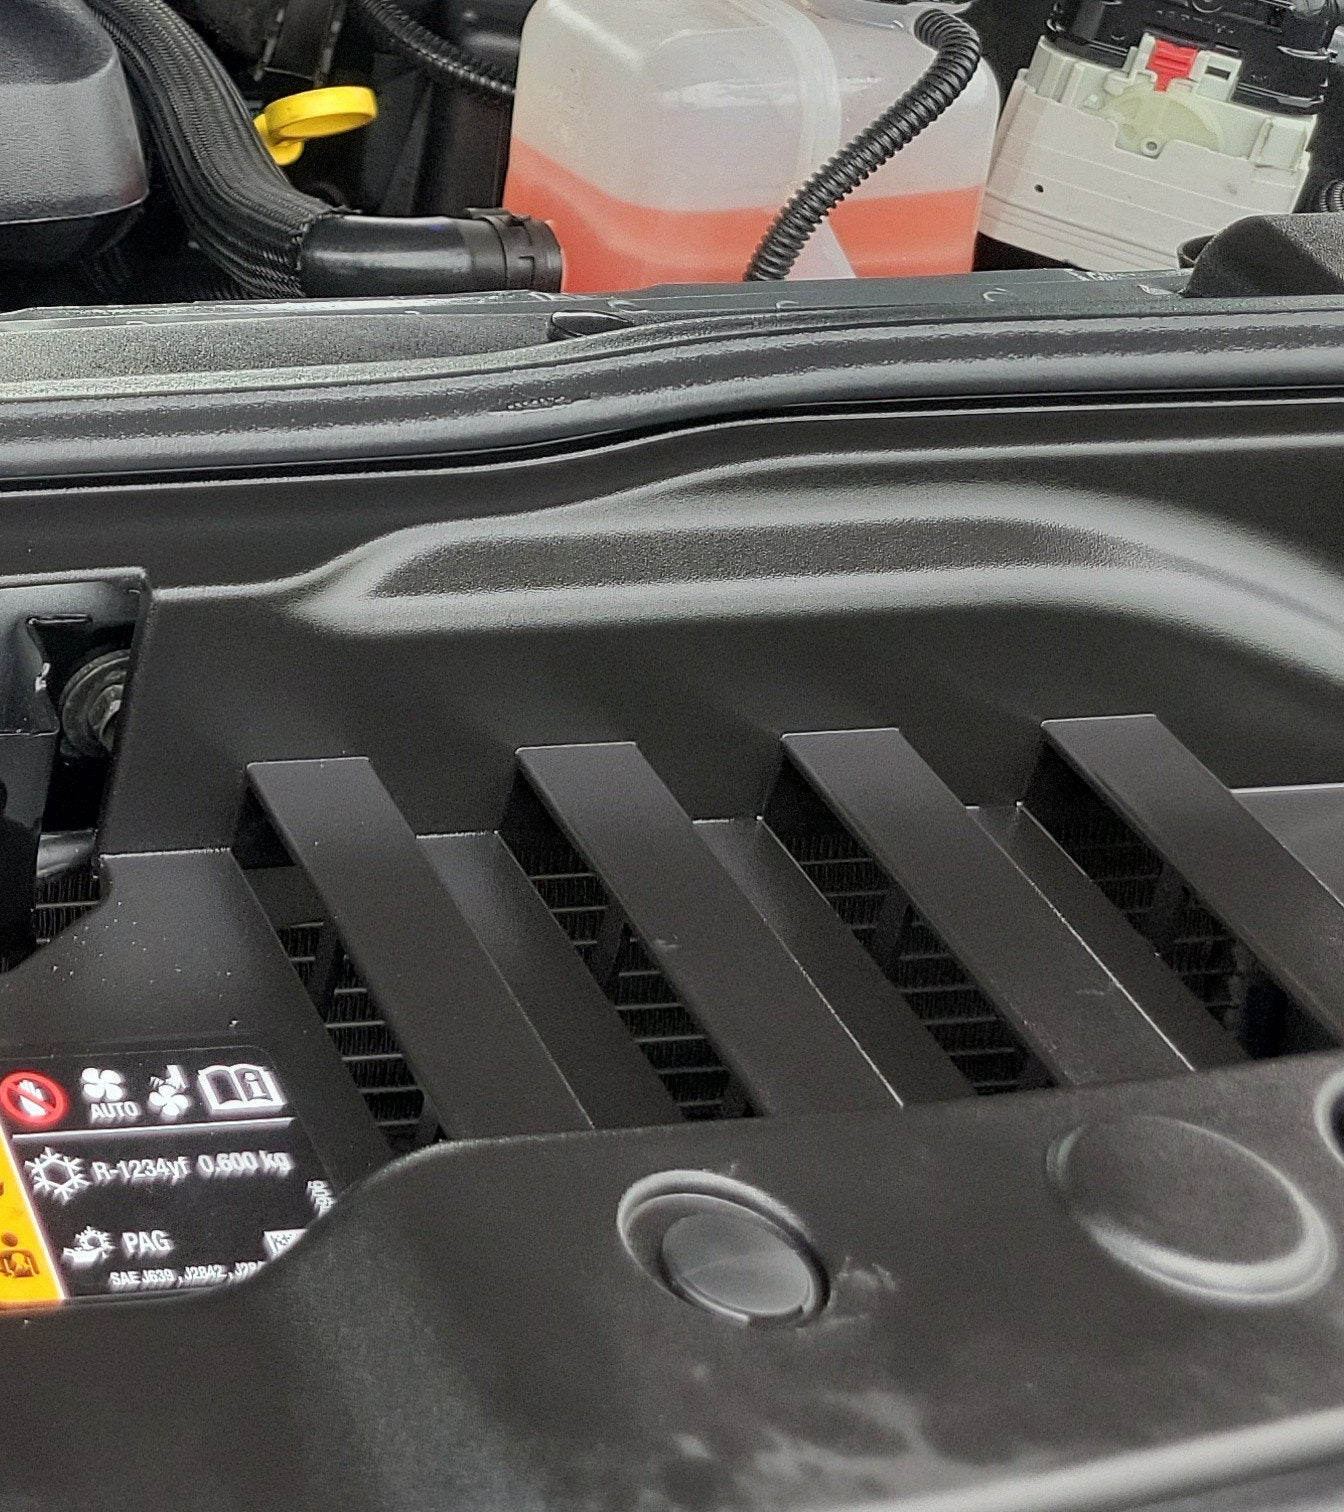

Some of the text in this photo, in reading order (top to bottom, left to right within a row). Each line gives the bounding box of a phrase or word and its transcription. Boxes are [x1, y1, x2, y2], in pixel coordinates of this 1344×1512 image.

[91, 1100, 139, 1120] AUTO
[92, 1149, 292, 1183] R-1234yf 0.600 kg
[121, 1230, 173, 1255] PAG
[109, 1270, 142, 1287] SAE
[141, 1268, 175, 1285] J639
